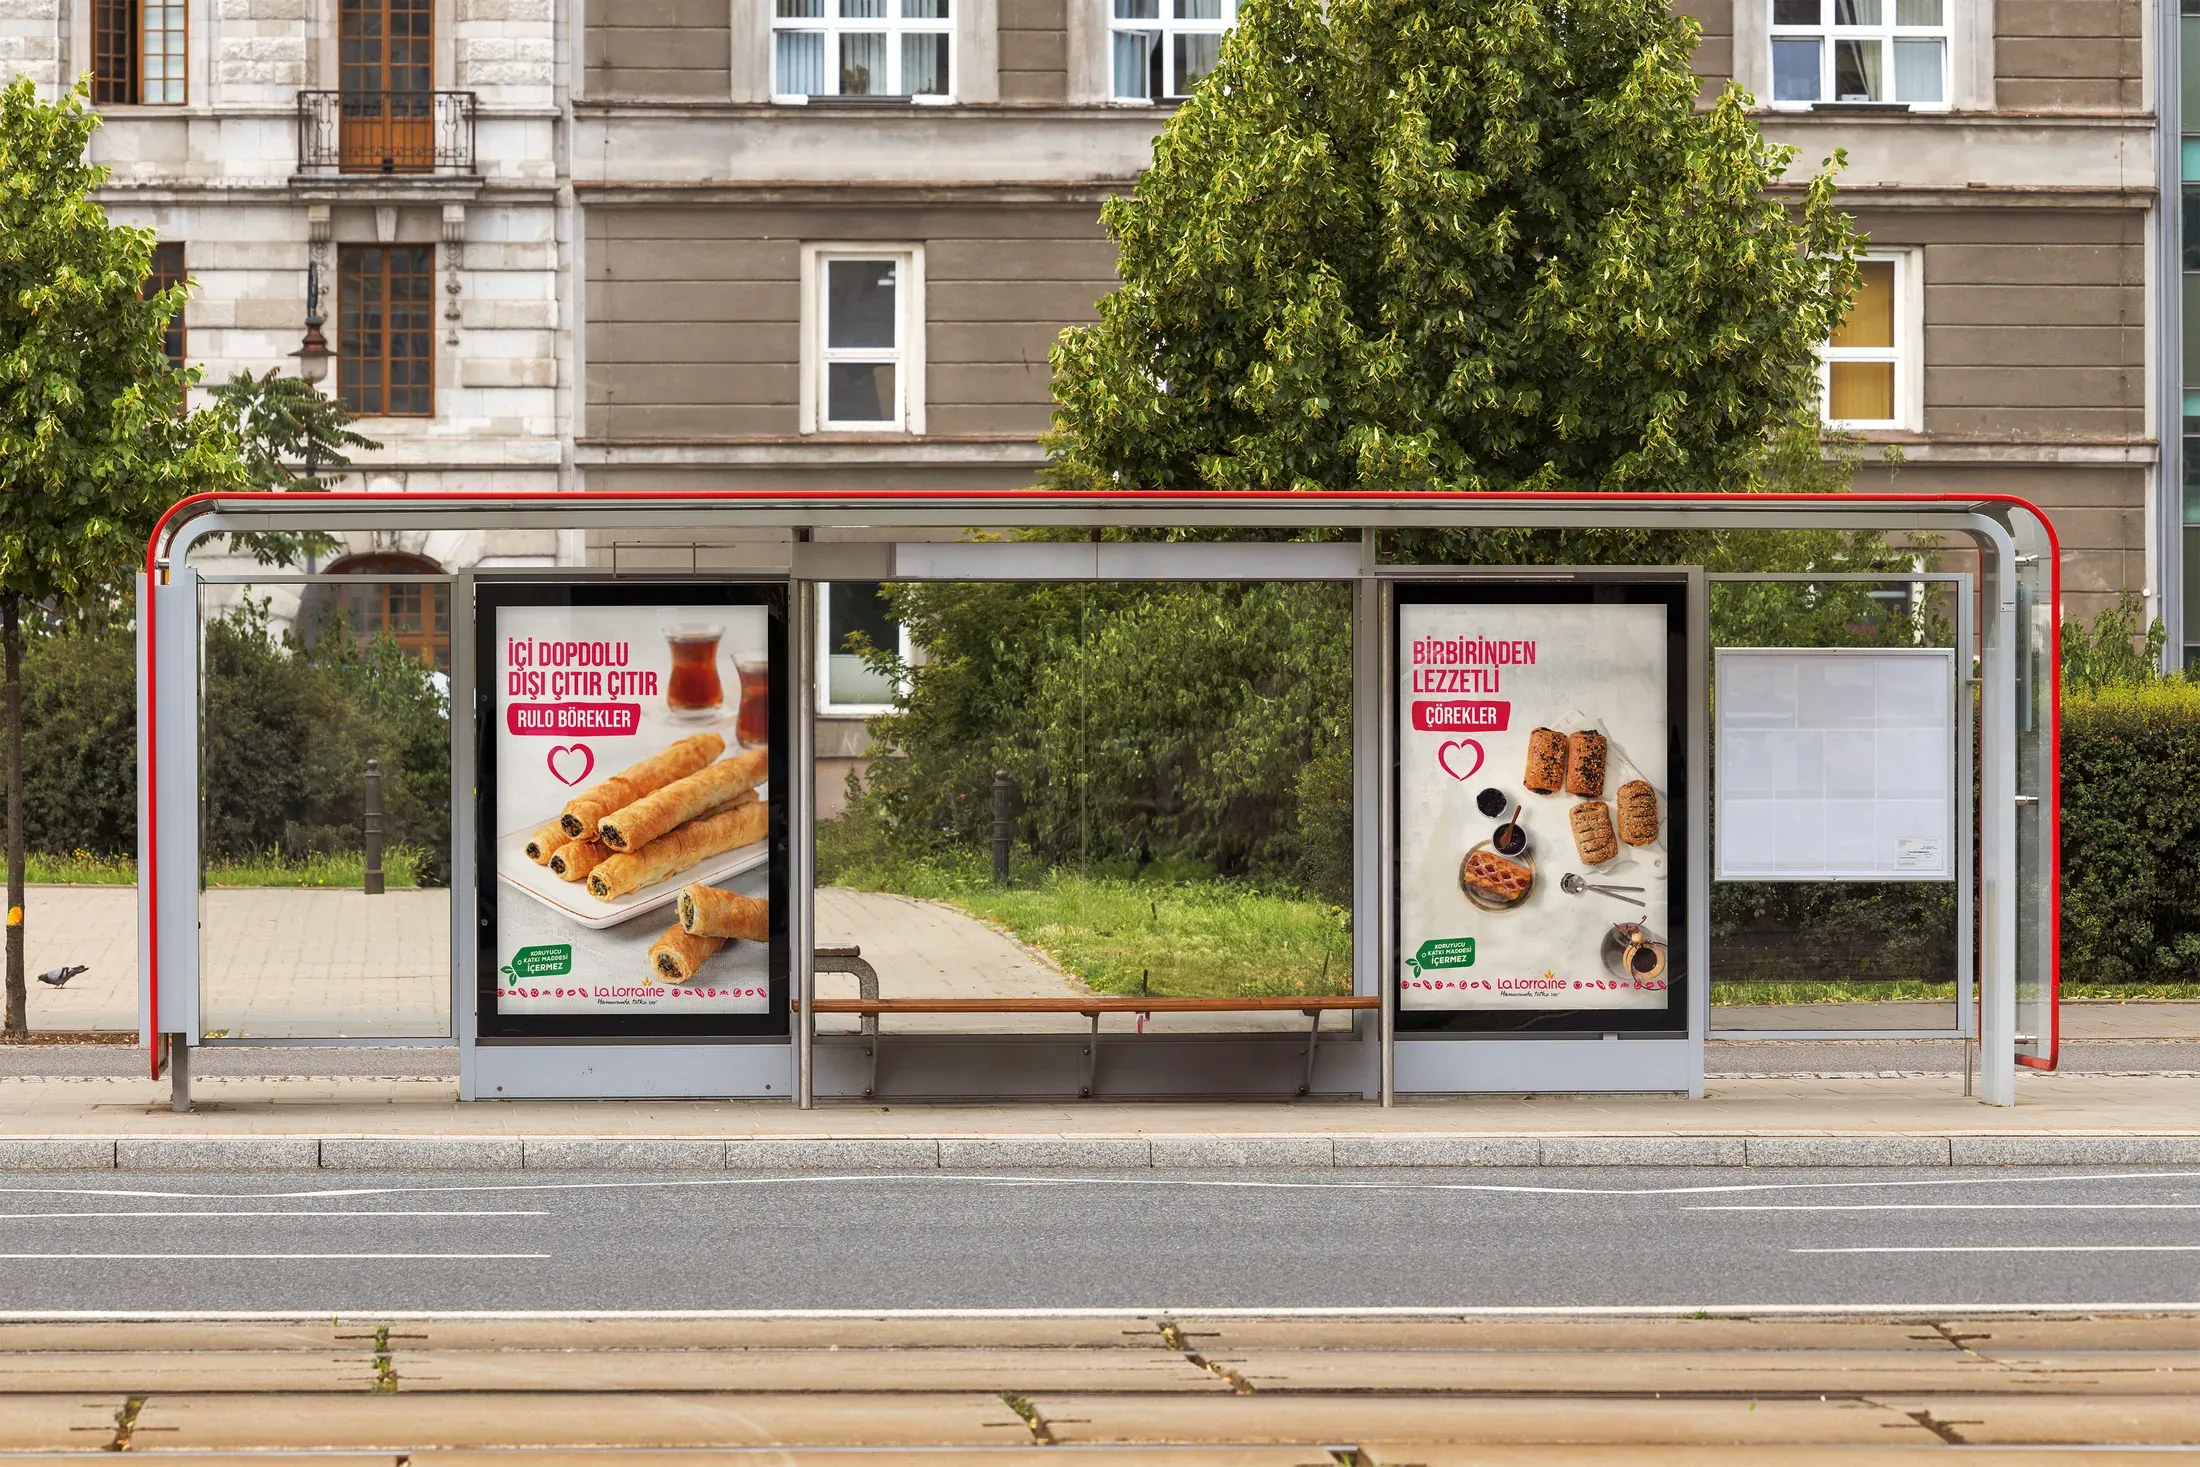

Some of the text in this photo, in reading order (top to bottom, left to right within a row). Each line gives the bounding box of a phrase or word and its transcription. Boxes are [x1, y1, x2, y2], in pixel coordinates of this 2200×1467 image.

[508, 637, 629, 671] İÇİ DOPDOLU
[1413, 635, 1536, 665] BİRBİRİNDEN
[508, 671, 658, 700] DIŞI ÇITIR ÇITIR
[1413, 663, 1500, 693] LEZZETLİ
[517, 706, 631, 728] RULO BÖREKLER
[1425, 703, 1497, 728] ÇÖREKLER
[1434, 942, 1466, 950] KORUYUCU
[527, 962, 563, 974] İÇERMEZ
[1431, 955, 1467, 967] İÇERMEZ
[594, 985, 665, 997] La Lorraine
[1497, 978, 1567, 990] La Lorraine
